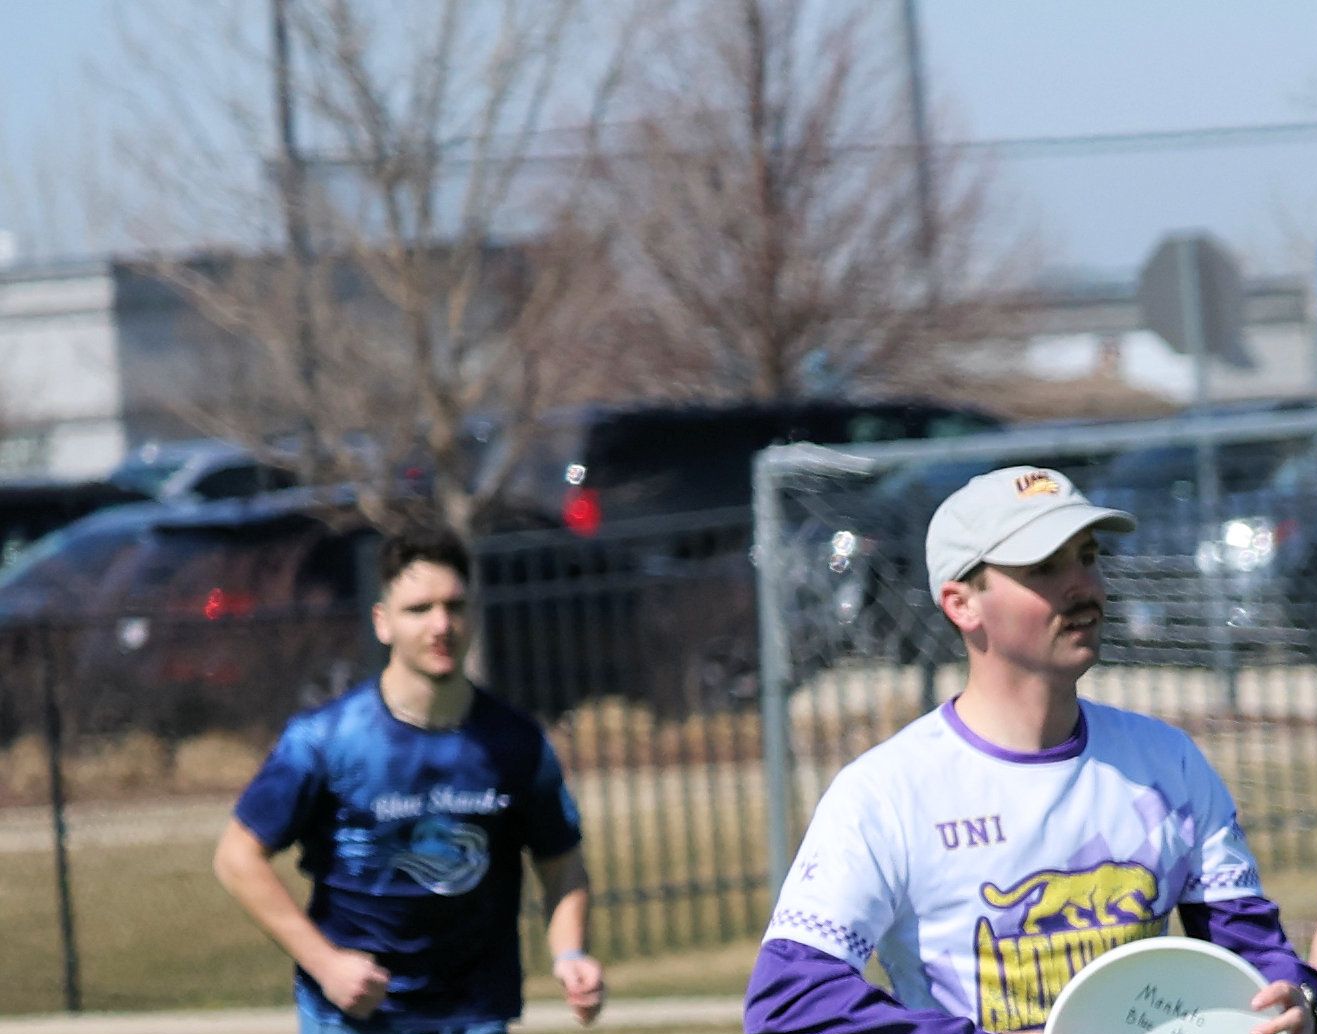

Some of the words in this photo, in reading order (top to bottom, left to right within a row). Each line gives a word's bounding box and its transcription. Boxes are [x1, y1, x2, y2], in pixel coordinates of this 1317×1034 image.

[935, 815, 1007, 850] UNI
[1125, 1006, 1155, 1032] Blue
[1134, 982, 1205, 1028] Mankato
